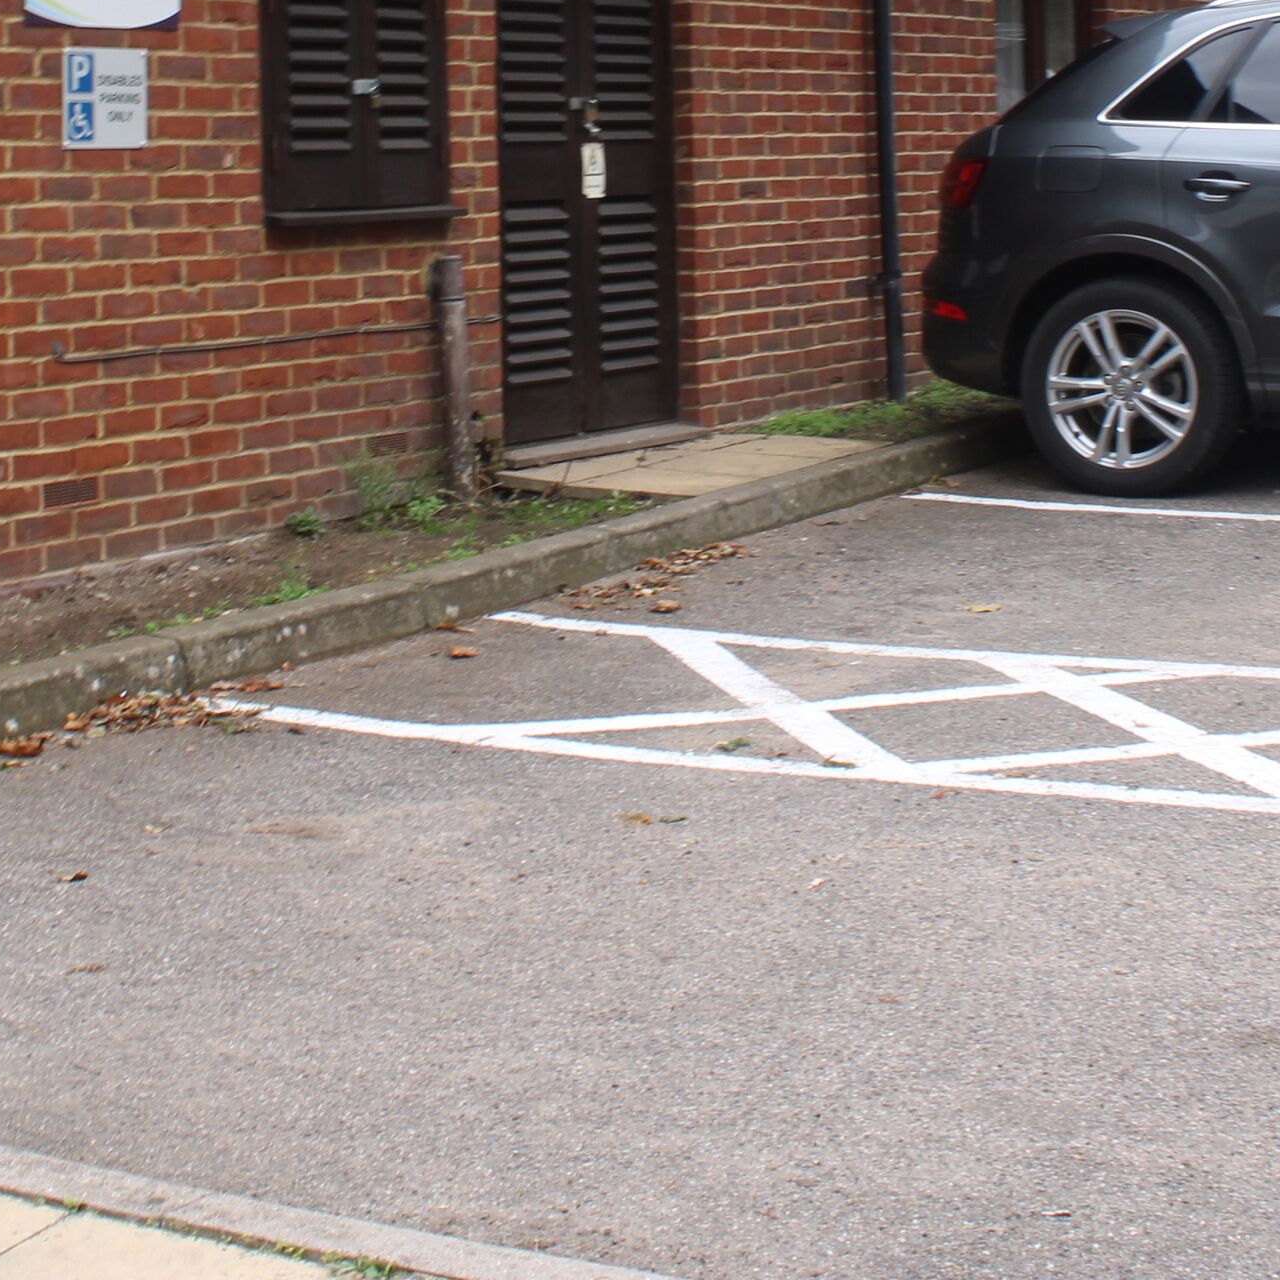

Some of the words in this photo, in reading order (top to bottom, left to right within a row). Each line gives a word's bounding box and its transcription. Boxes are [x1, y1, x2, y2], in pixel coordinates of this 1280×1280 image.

[71, 55, 91, 91] P
[99, 92, 141, 105] PARKING
[107, 110, 134, 123] ONLY
